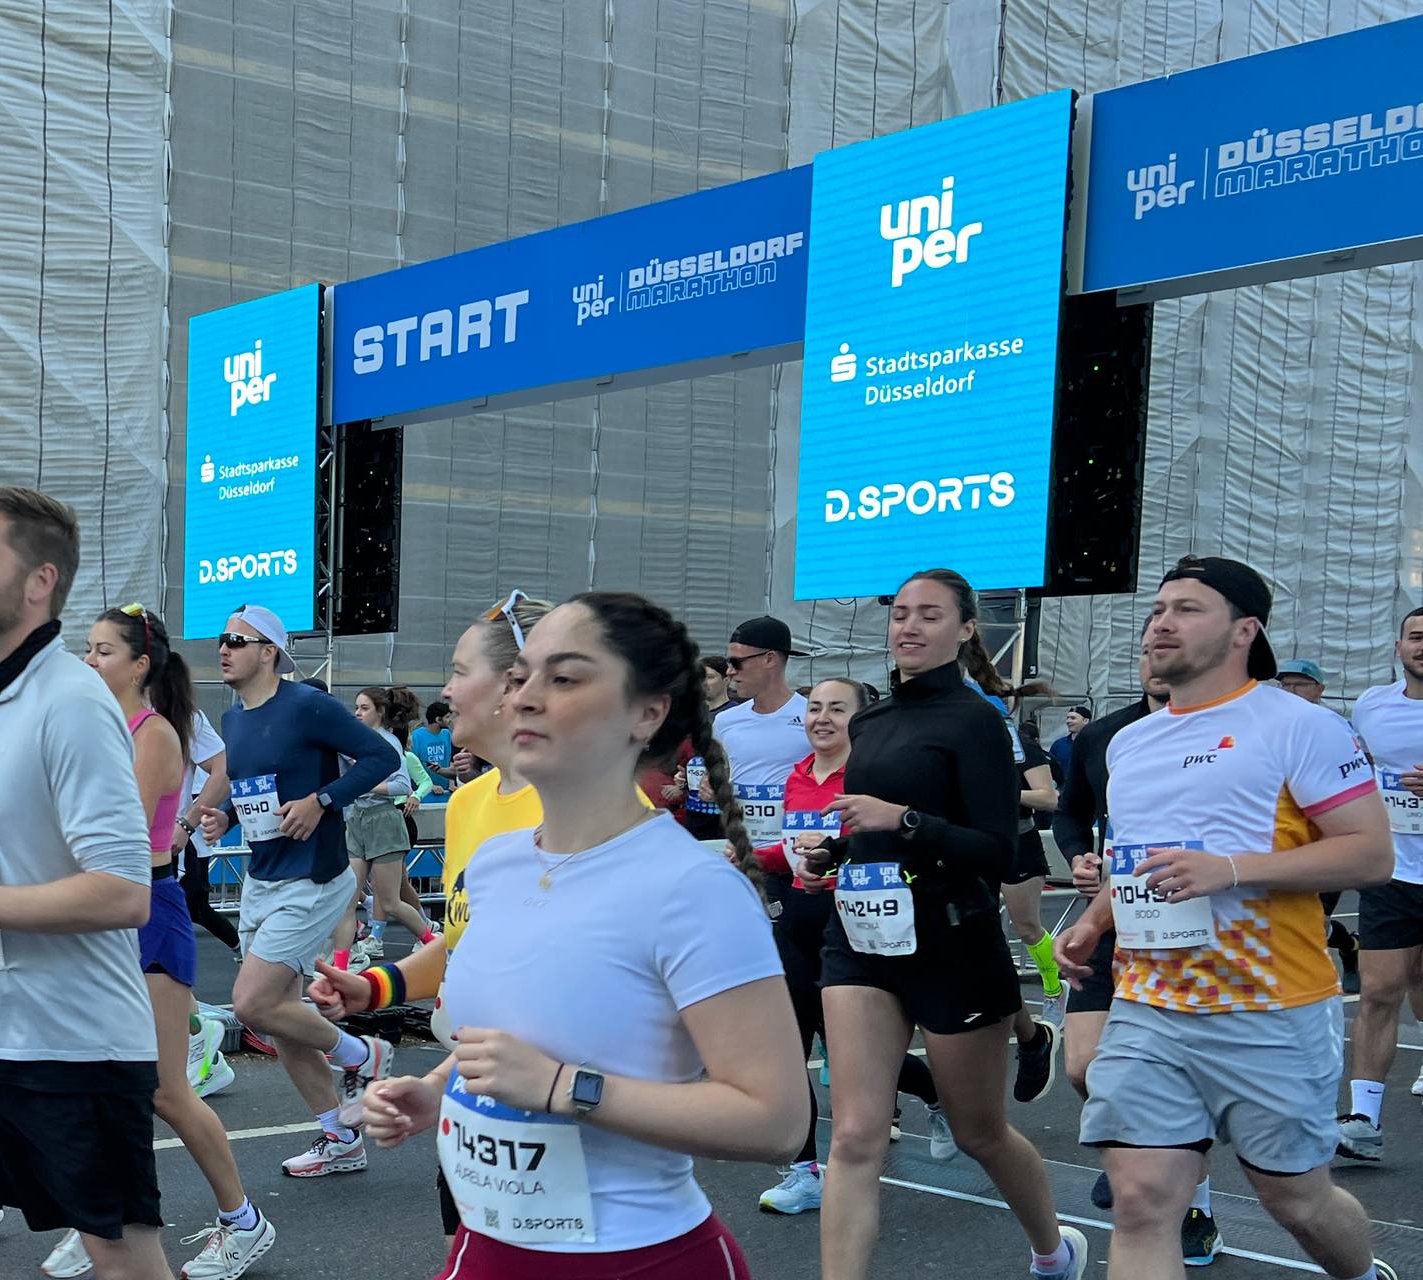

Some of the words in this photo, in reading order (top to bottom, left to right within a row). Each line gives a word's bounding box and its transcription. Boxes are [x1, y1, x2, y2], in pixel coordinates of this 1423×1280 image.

[1218, 103, 1423, 169] DÜSSELD
[1128, 153, 1177, 191] uni
[880, 176, 955, 240] uni
[1135, 180, 1195, 220] per
[628, 231, 804, 289] DÜSSELDORF
[892, 222, 982, 287] per
[573, 275, 604, 303] uni
[627, 261, 776, 311] MARATHON
[577, 295, 615, 326] per
[353, 290, 529, 376] START
[224, 339, 262, 383] uni
[865, 337, 1024, 377] Stadtsparkasse
[231, 376, 277, 416] per
[865, 371, 976, 406] Düsseldorf
[218, 454, 299, 480] Stadtsparkasse
[218, 476, 276, 501] Düsseldorf
[825, 472, 1015, 522] D.SPORTS
[199, 548, 297, 584] D.SPORTS
[1182, 752, 1217, 768] pwc
[453, 1121, 547, 1171] 14317
[493, 1178, 546, 1196] VIOLA
[512, 1217, 585, 1231] D.SPORTS
